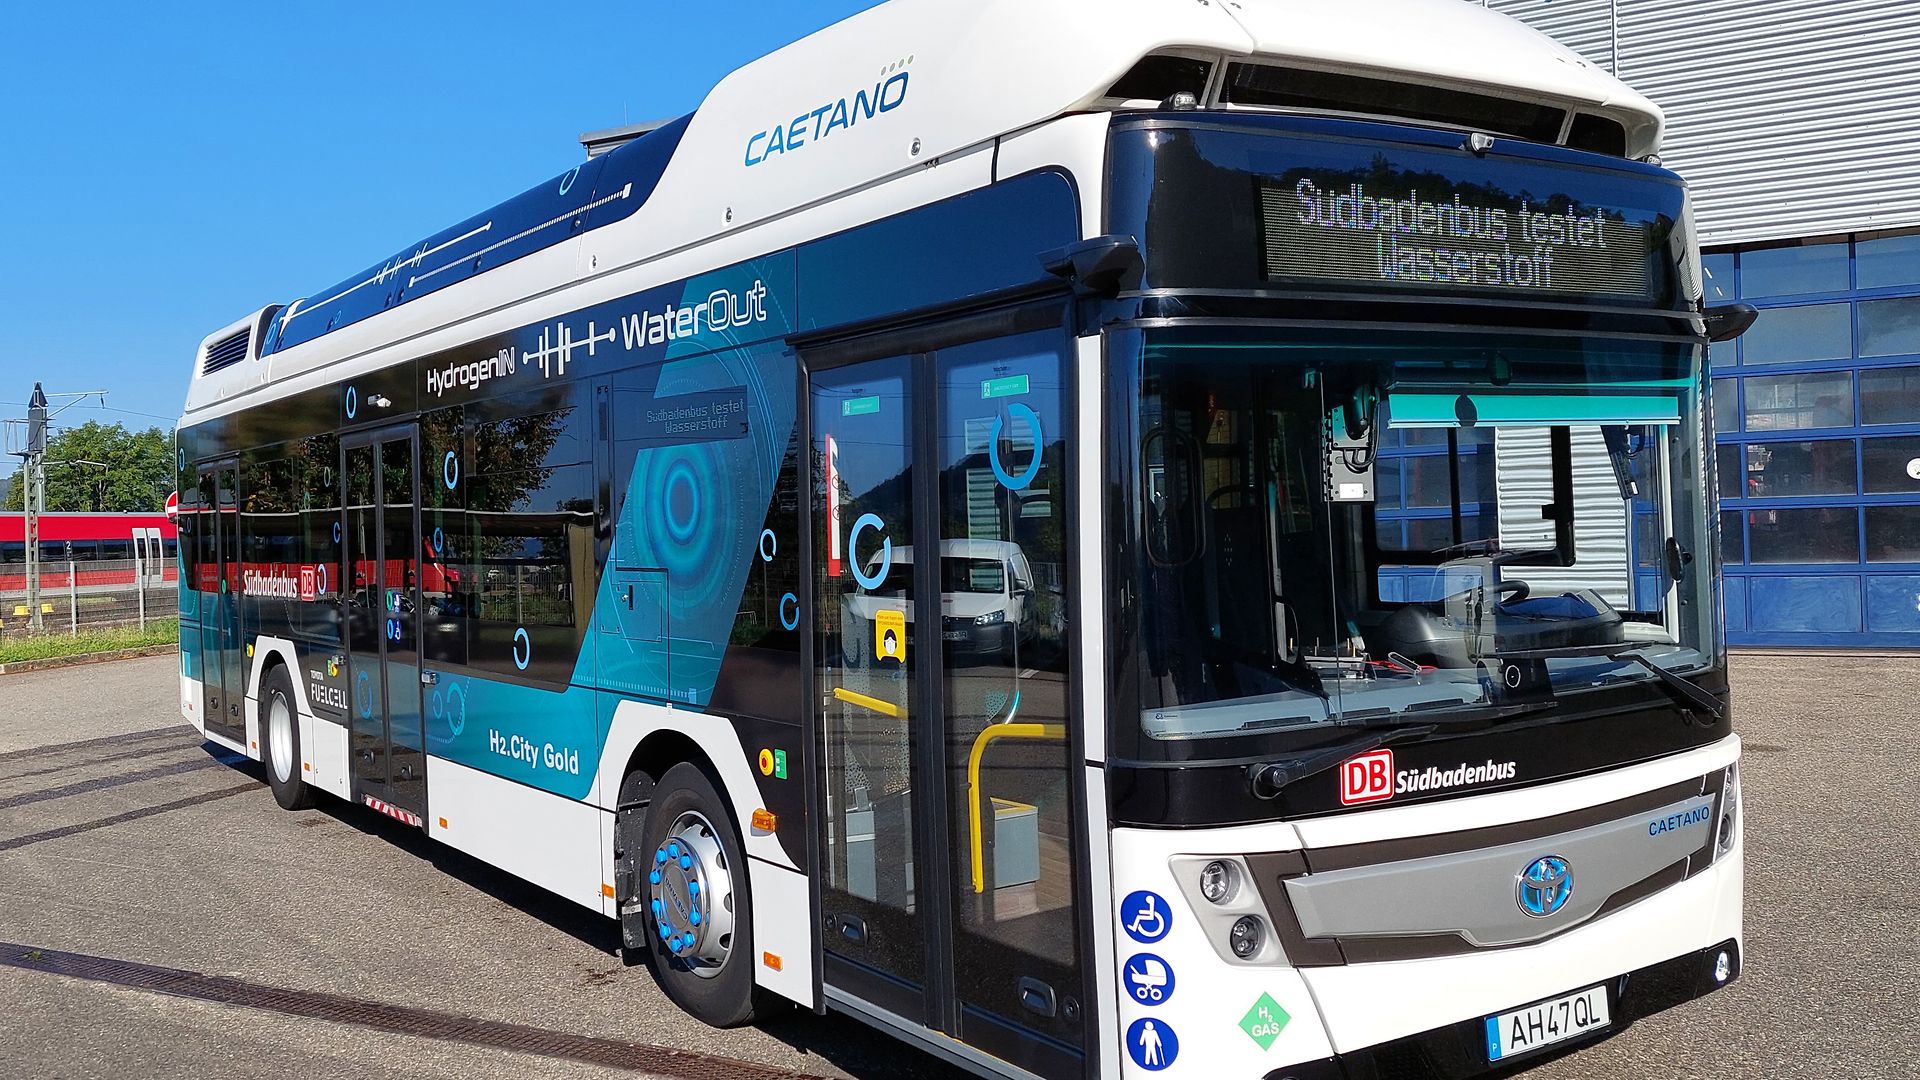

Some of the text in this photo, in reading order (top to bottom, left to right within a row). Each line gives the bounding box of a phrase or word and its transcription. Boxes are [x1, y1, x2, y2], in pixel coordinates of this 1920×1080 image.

[745, 72, 909, 167] CAETANO
[1518, 200, 1607, 249] testet
[1377, 232, 1554, 288] Wasserstoff
[622, 280, 766, 350] WaterOut
[427, 346, 515, 398] HydrogenIN
[711, 398, 744, 415] testet
[65, 540, 71, 550] 2
[243, 569, 298, 598] Südbadenbus
[311, 682, 348, 710] FUELCELL
[489, 728, 579, 775] H2.City Gold
[1349, 759, 1516, 795] DB Südbadenbus
[1648, 806, 1710, 836] CAETANO
[1252, 1022, 1280, 1037] GAS
[1510, 994, 1601, 1050] AH47QL
[1492, 1042, 1497, 1053] P
